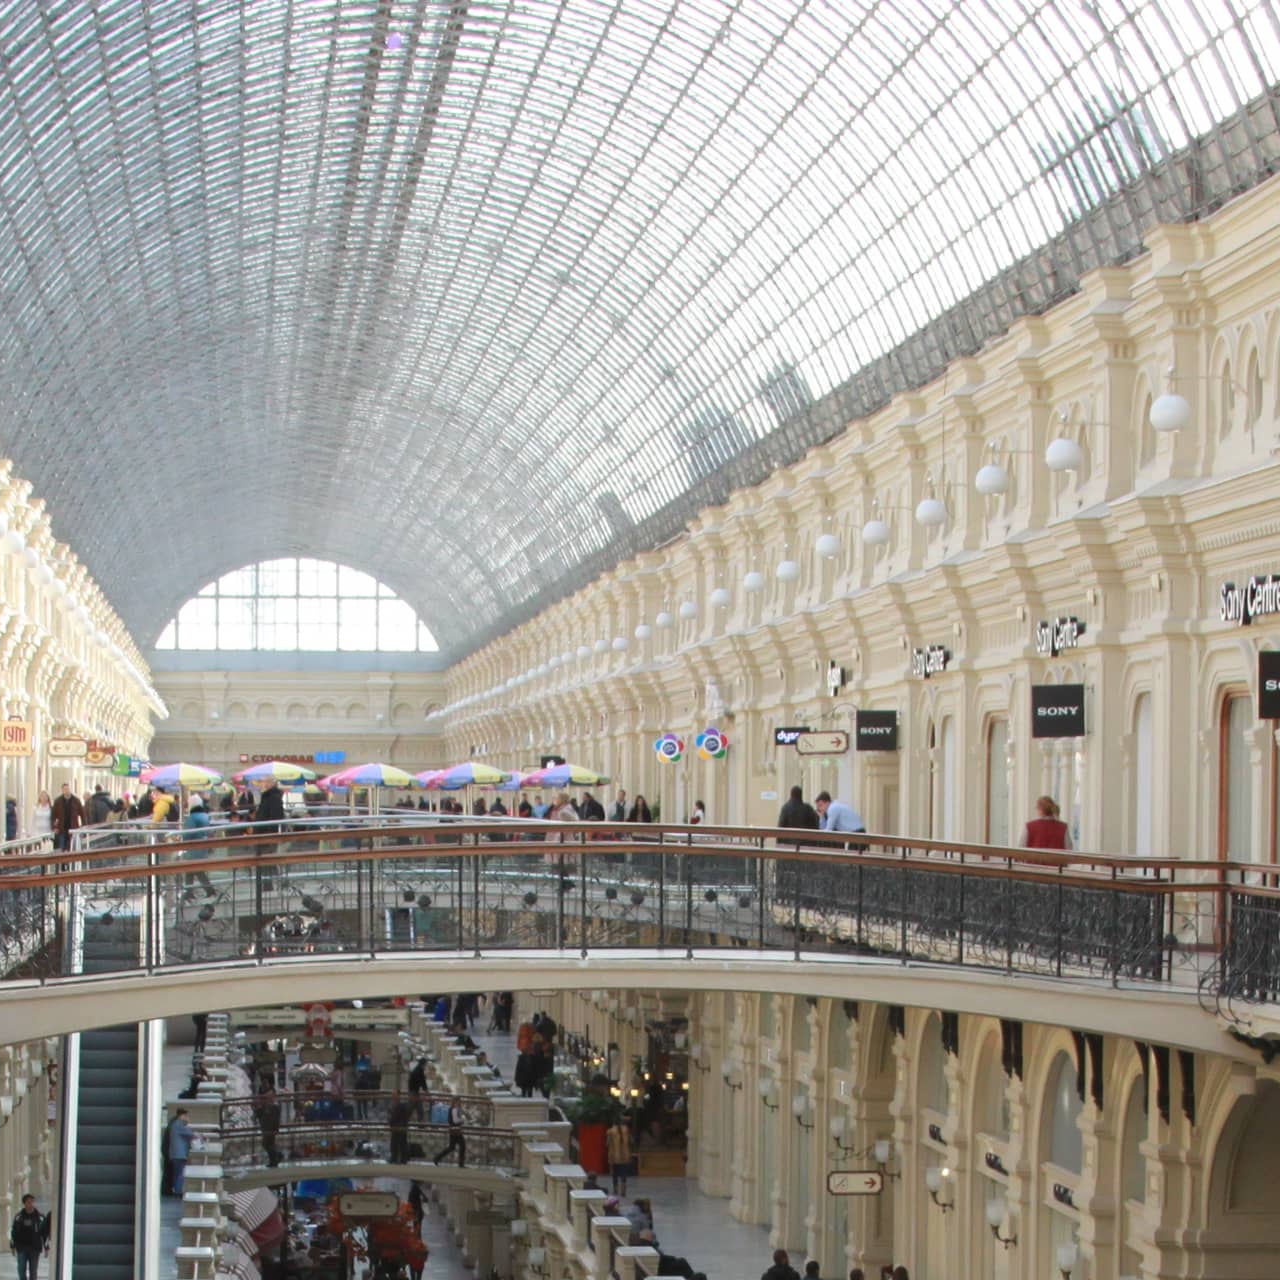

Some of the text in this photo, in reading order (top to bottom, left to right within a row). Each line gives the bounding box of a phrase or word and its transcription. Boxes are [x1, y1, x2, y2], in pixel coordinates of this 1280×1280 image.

[1219, 582, 1246, 626] Sony
[1037, 706, 1079, 716] SONY
[3, 725, 26, 743] ГУМ
[776, 730, 800, 743] dys
[860, 727, 892, 735] SONY
